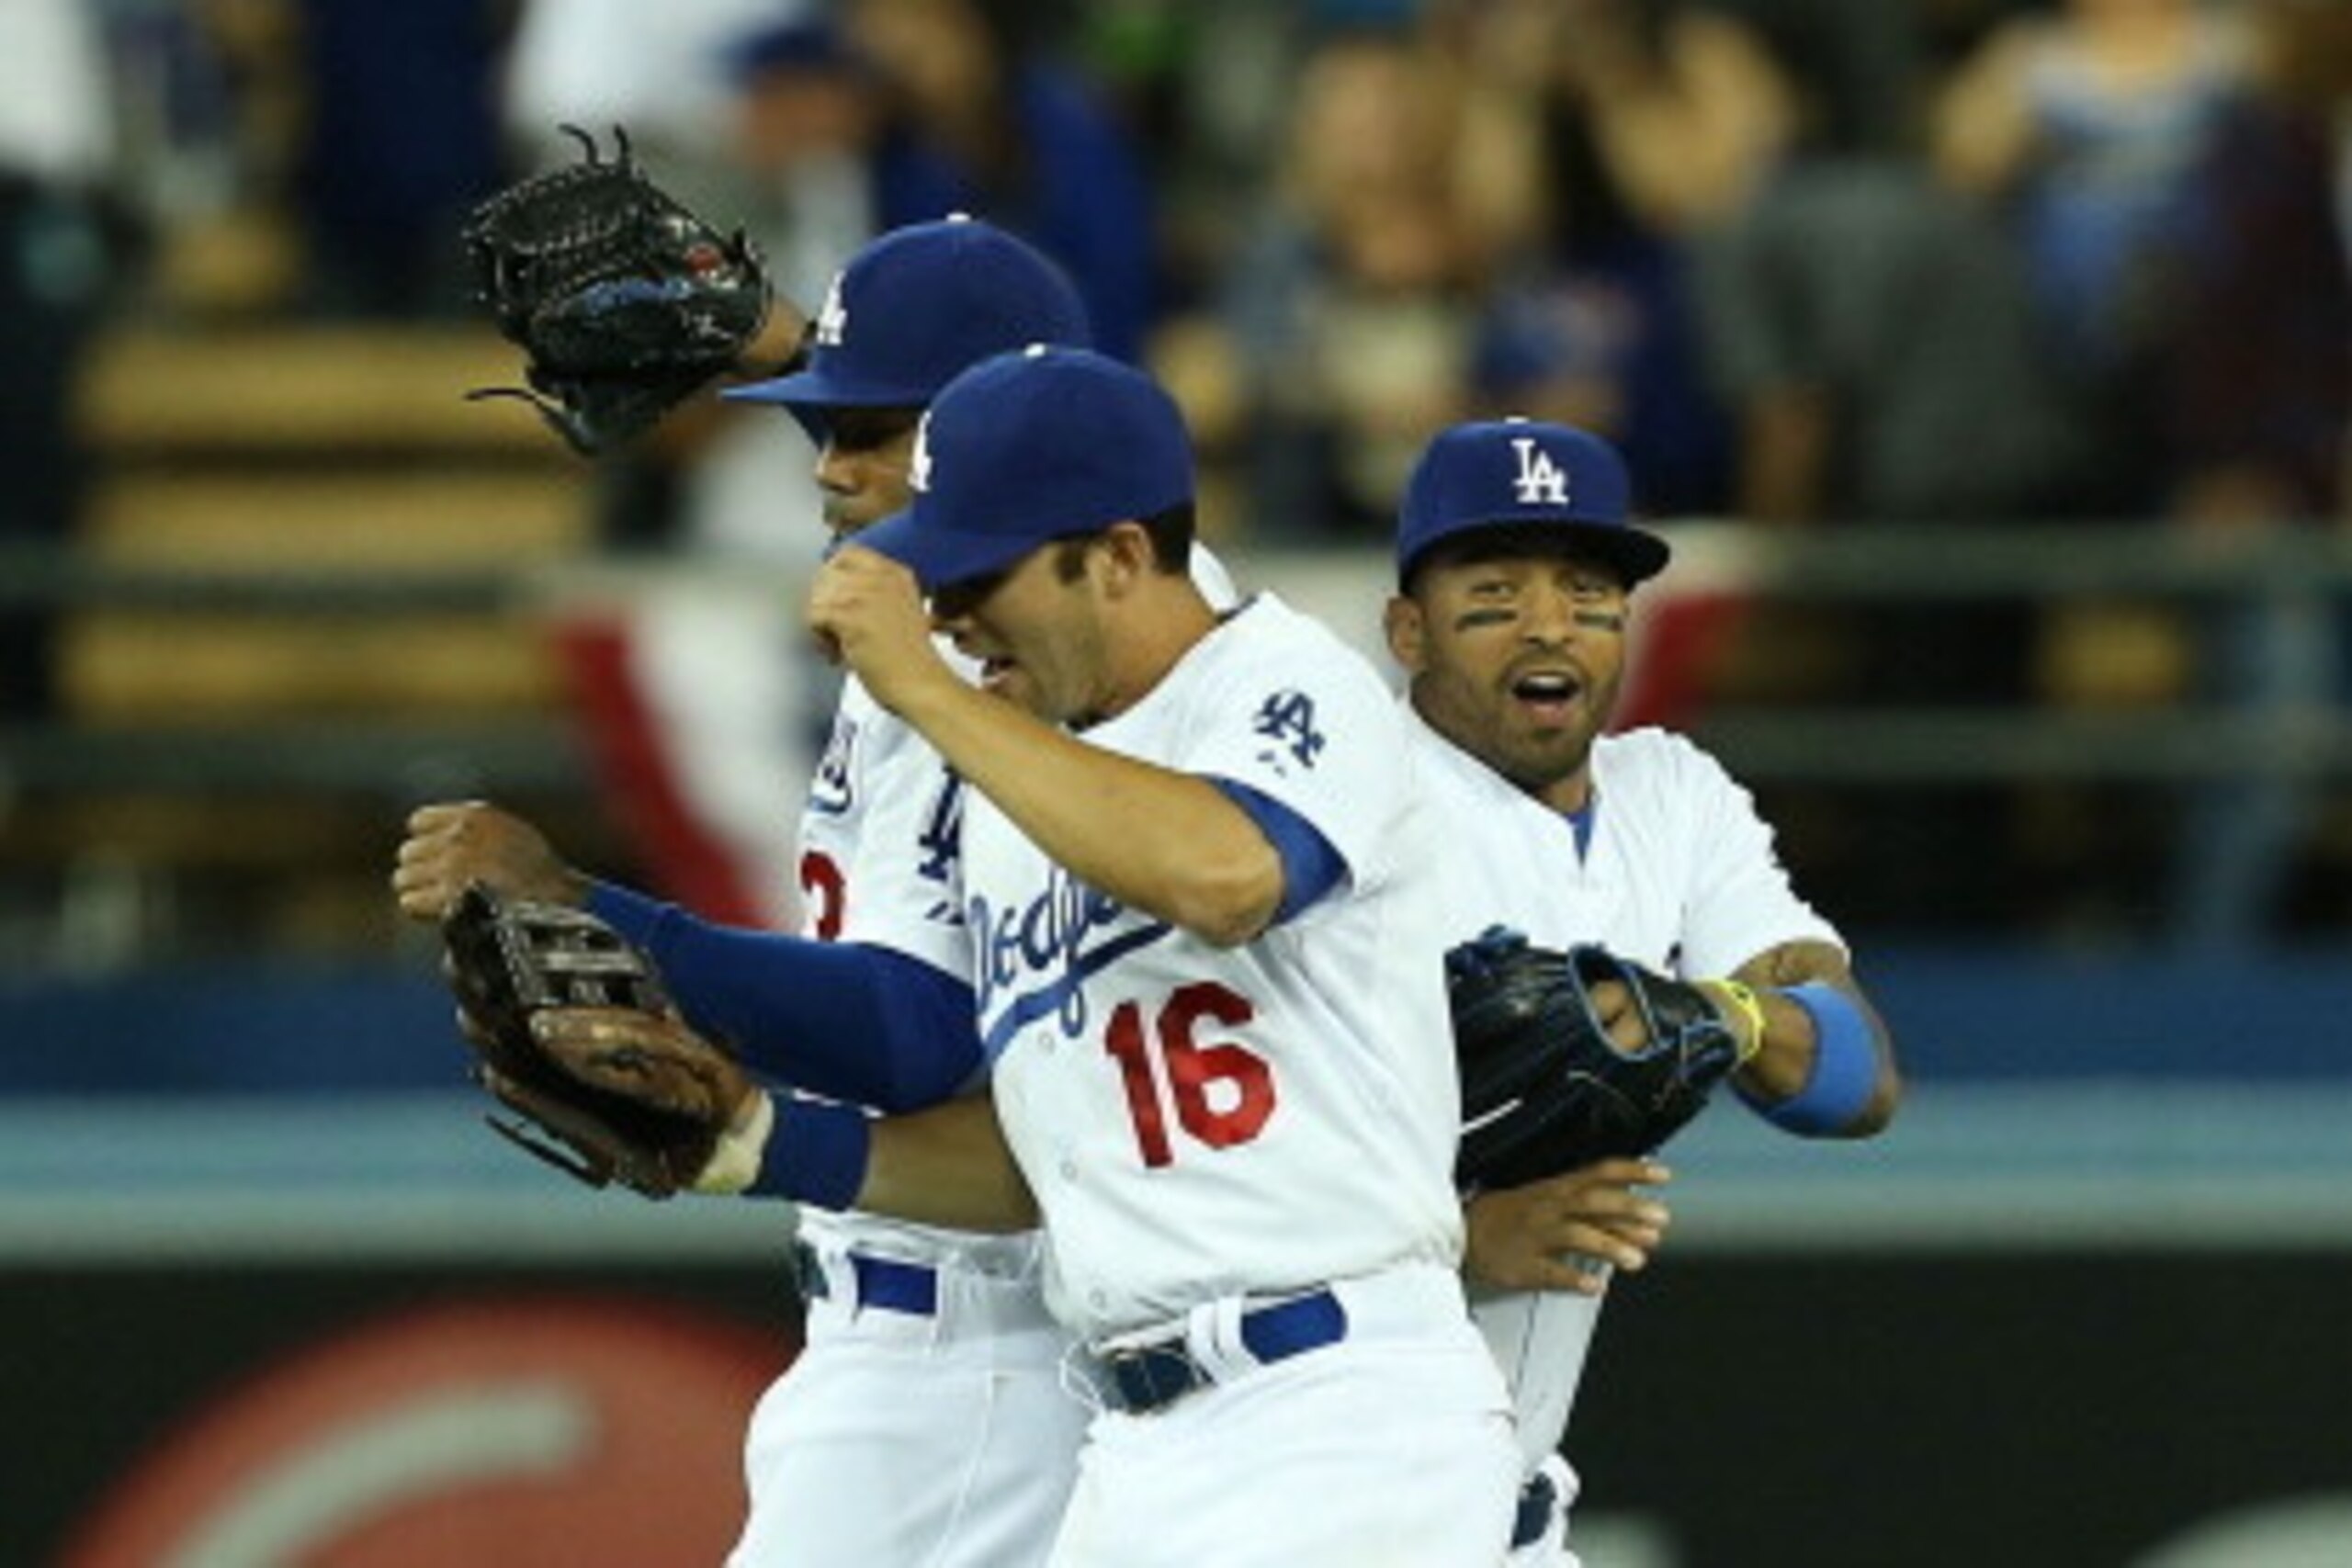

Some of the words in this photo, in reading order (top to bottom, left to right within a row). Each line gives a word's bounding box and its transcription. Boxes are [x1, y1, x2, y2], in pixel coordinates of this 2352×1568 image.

[1510, 439, 1569, 503] LA
[1252, 689, 1326, 769] LA
[1105, 981, 1276, 1169] 16
